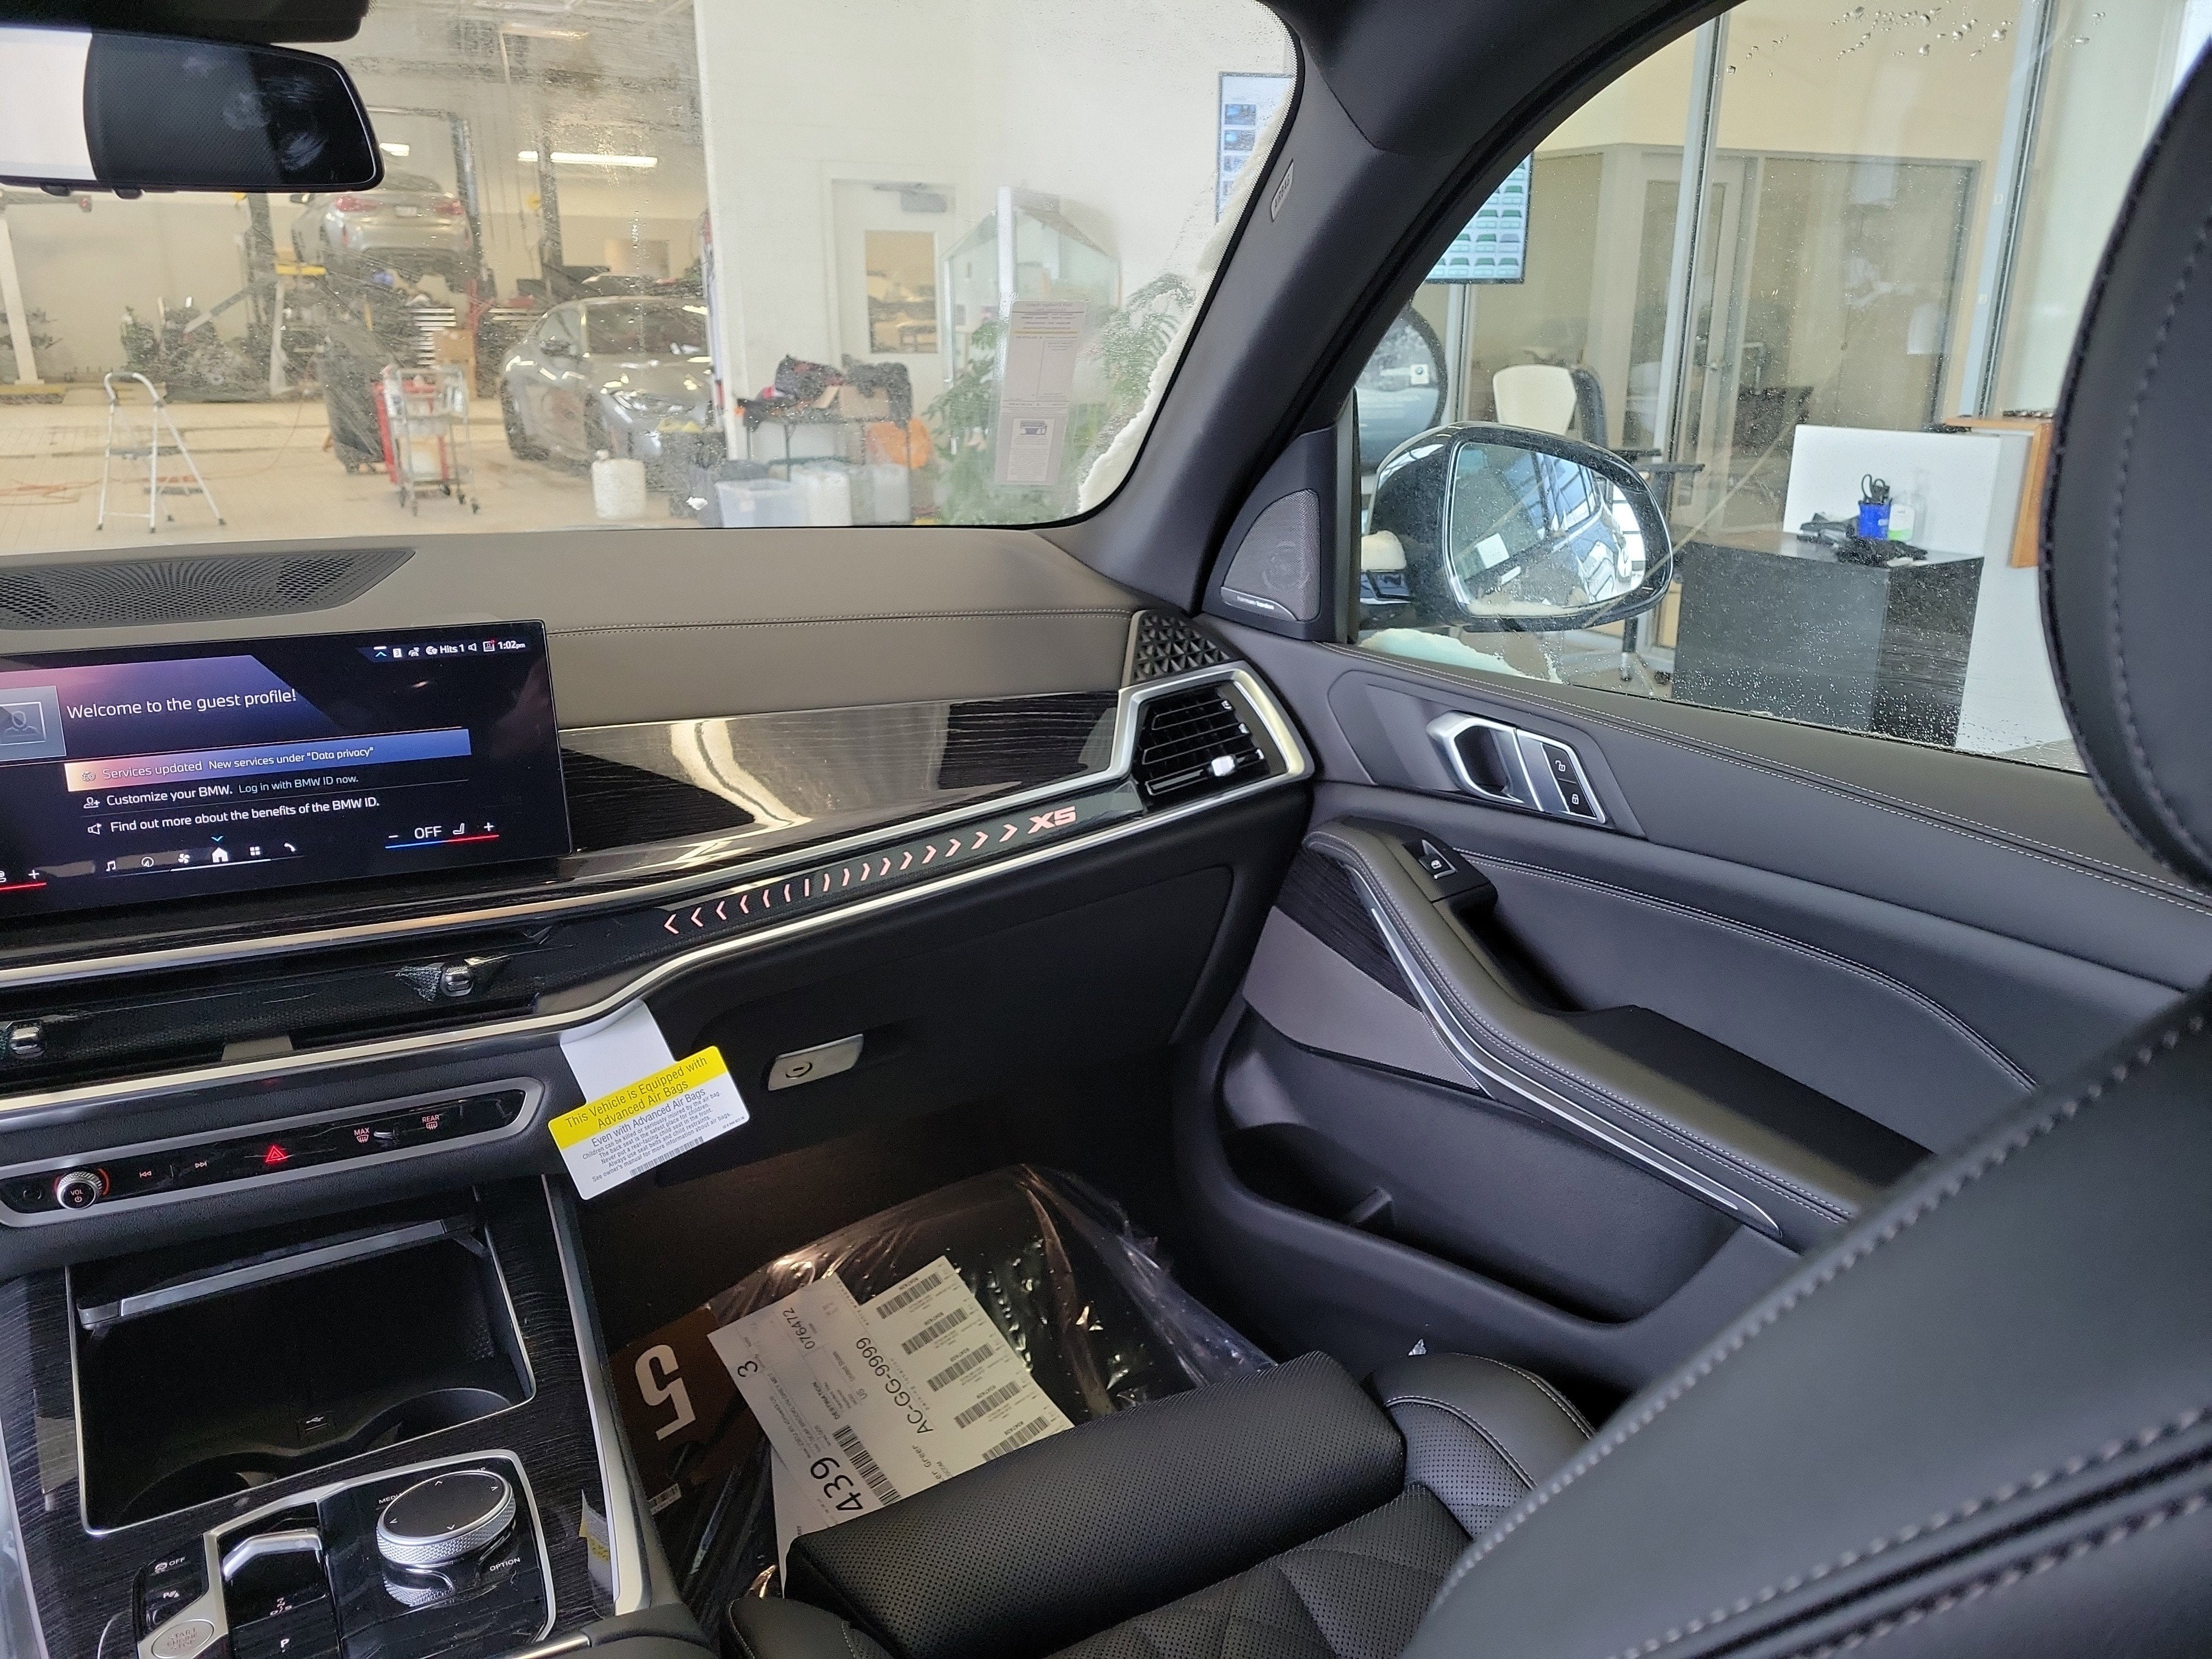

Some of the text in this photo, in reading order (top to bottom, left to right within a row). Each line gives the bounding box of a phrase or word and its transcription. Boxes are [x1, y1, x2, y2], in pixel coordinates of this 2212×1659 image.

[440, 645, 458, 653] Hits
[498, 641, 526, 650] 1:02pm
[66, 689, 297, 719] Welcome to the guest profile!
[103, 747, 374, 779] Services updated New services under "Data privacy"
[106, 775, 359, 806] Customize your BMW. Log in with BMW ID now.
[110, 797, 380, 832] Find out more about the benefits of the BMW ID.
[1027, 806, 1076, 834] X5
[414, 826, 442, 839] OFF
[565, 1056, 707, 1128] This Vehicle is Equipped with
[596, 1079, 689, 1128] Advanced Air Bags
[353, 1127, 370, 1136] MAX
[422, 1115, 439, 1123] REAR
[582, 1146, 604, 1159] Children
[622, 1131, 636, 1140] killed
[644, 1116, 667, 1130] seriously
[667, 1108, 685, 1120] injured
[710, 1091, 721, 1099] bag.
[591, 1087, 706, 1147] Even with Advanced Air Bags
[599, 1150, 609, 1158] The
[610, 1144, 622, 1153] back
[649, 1124, 664, 1133] safest
[665, 1117, 679, 1127] place
[688, 1102, 709, 1115] children.
[592, 1173, 602, 1182] See
[623, 1154, 642, 1166] manual
[651, 1144, 664, 1153] more
[665, 1129, 694, 1146] information
[695, 1122, 709, 1132] about
[601, 1153, 616, 1164] Never
[631, 1133, 658, 1150] rear-facing
[658, 1127, 672, 1136] child
[608, 1155, 627, 1167] Always
[648, 1138, 661, 1147] belts
[673, 1127, 685, 1136] child
[782, 1306, 816, 1350] 076472
[735, 1360, 758, 1379] 3
[855, 1336, 934, 1431] AC-GG-9999
[809, 1455, 862, 1513] 439
[169, 1557, 185, 1566] OFF
[490, 1557, 521, 1571] OPTION
[168, 1628, 196, 1640] START
[281, 1638, 290, 1648] P
